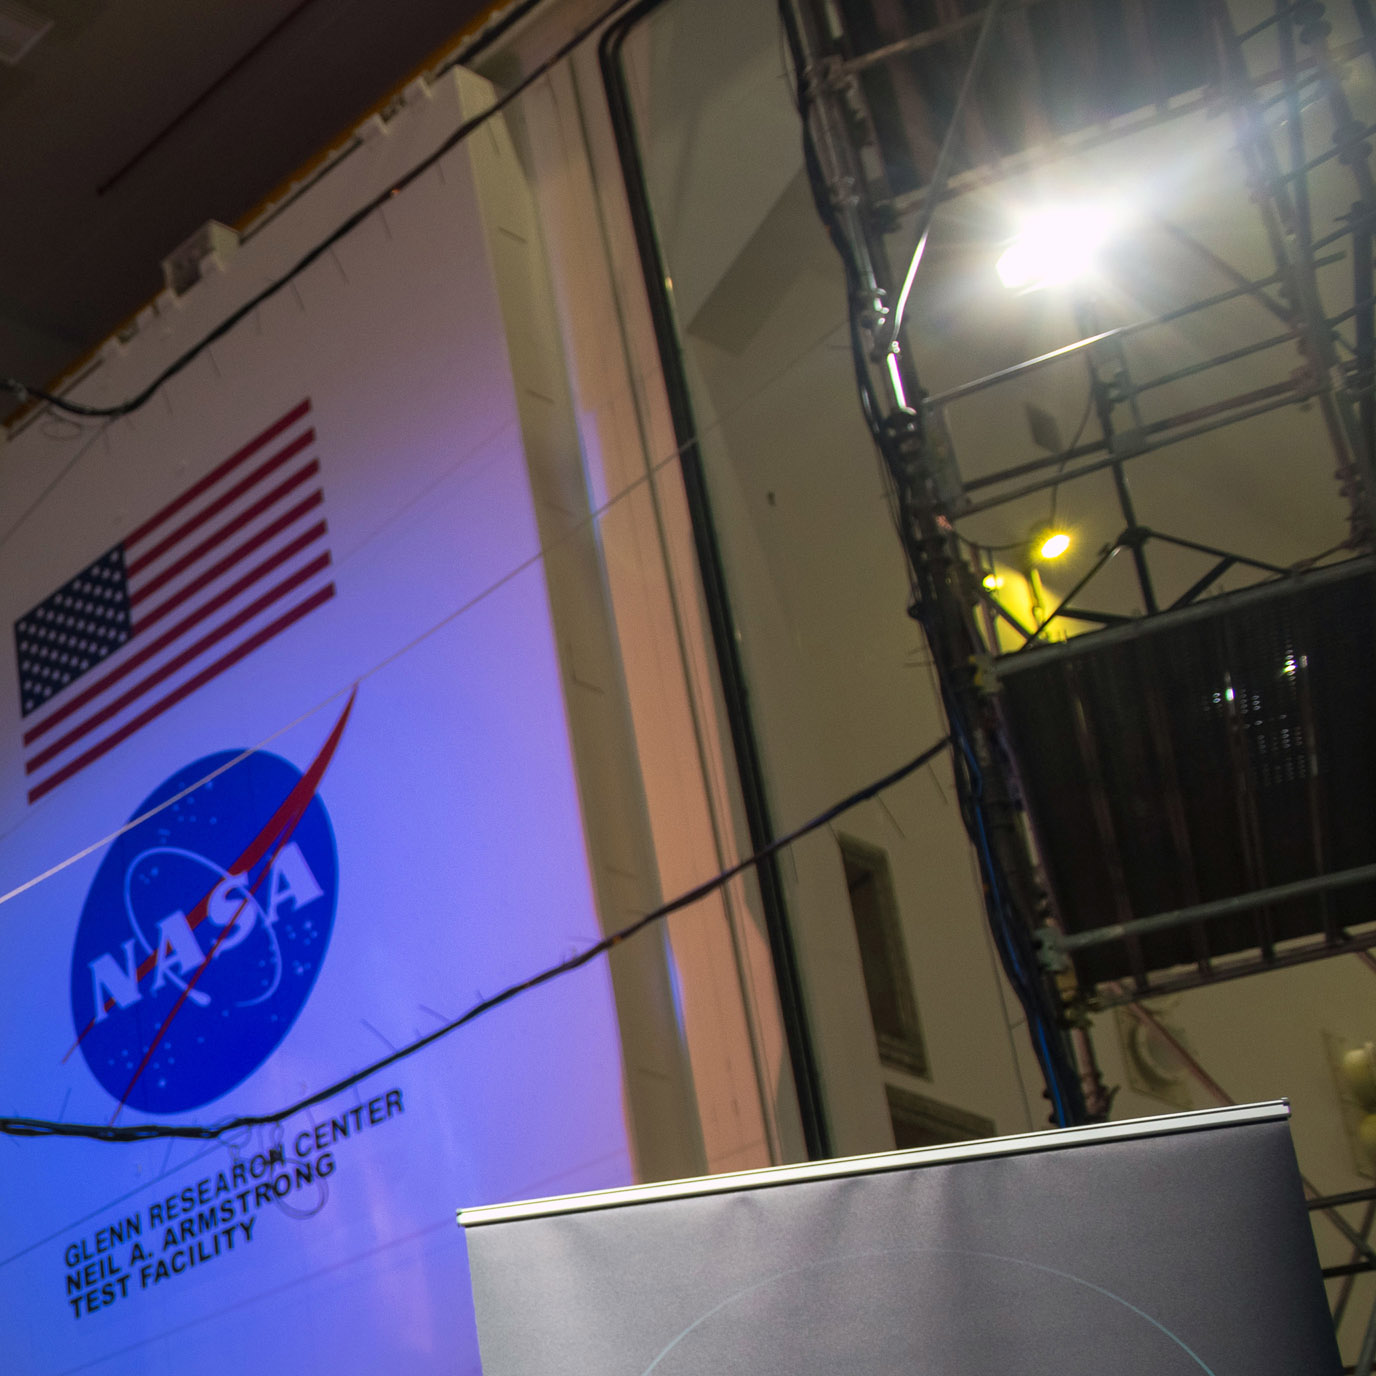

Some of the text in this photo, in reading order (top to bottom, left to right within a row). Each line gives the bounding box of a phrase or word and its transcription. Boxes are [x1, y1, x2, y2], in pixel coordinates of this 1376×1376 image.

[88, 842, 324, 1024] NASA
[64, 1087, 405, 1269] GLENN RESEARCH CENTER
[65, 1152, 337, 1296] NEIL A. ARMSTRONG
[69, 1216, 258, 1320] TEST FACILITY
